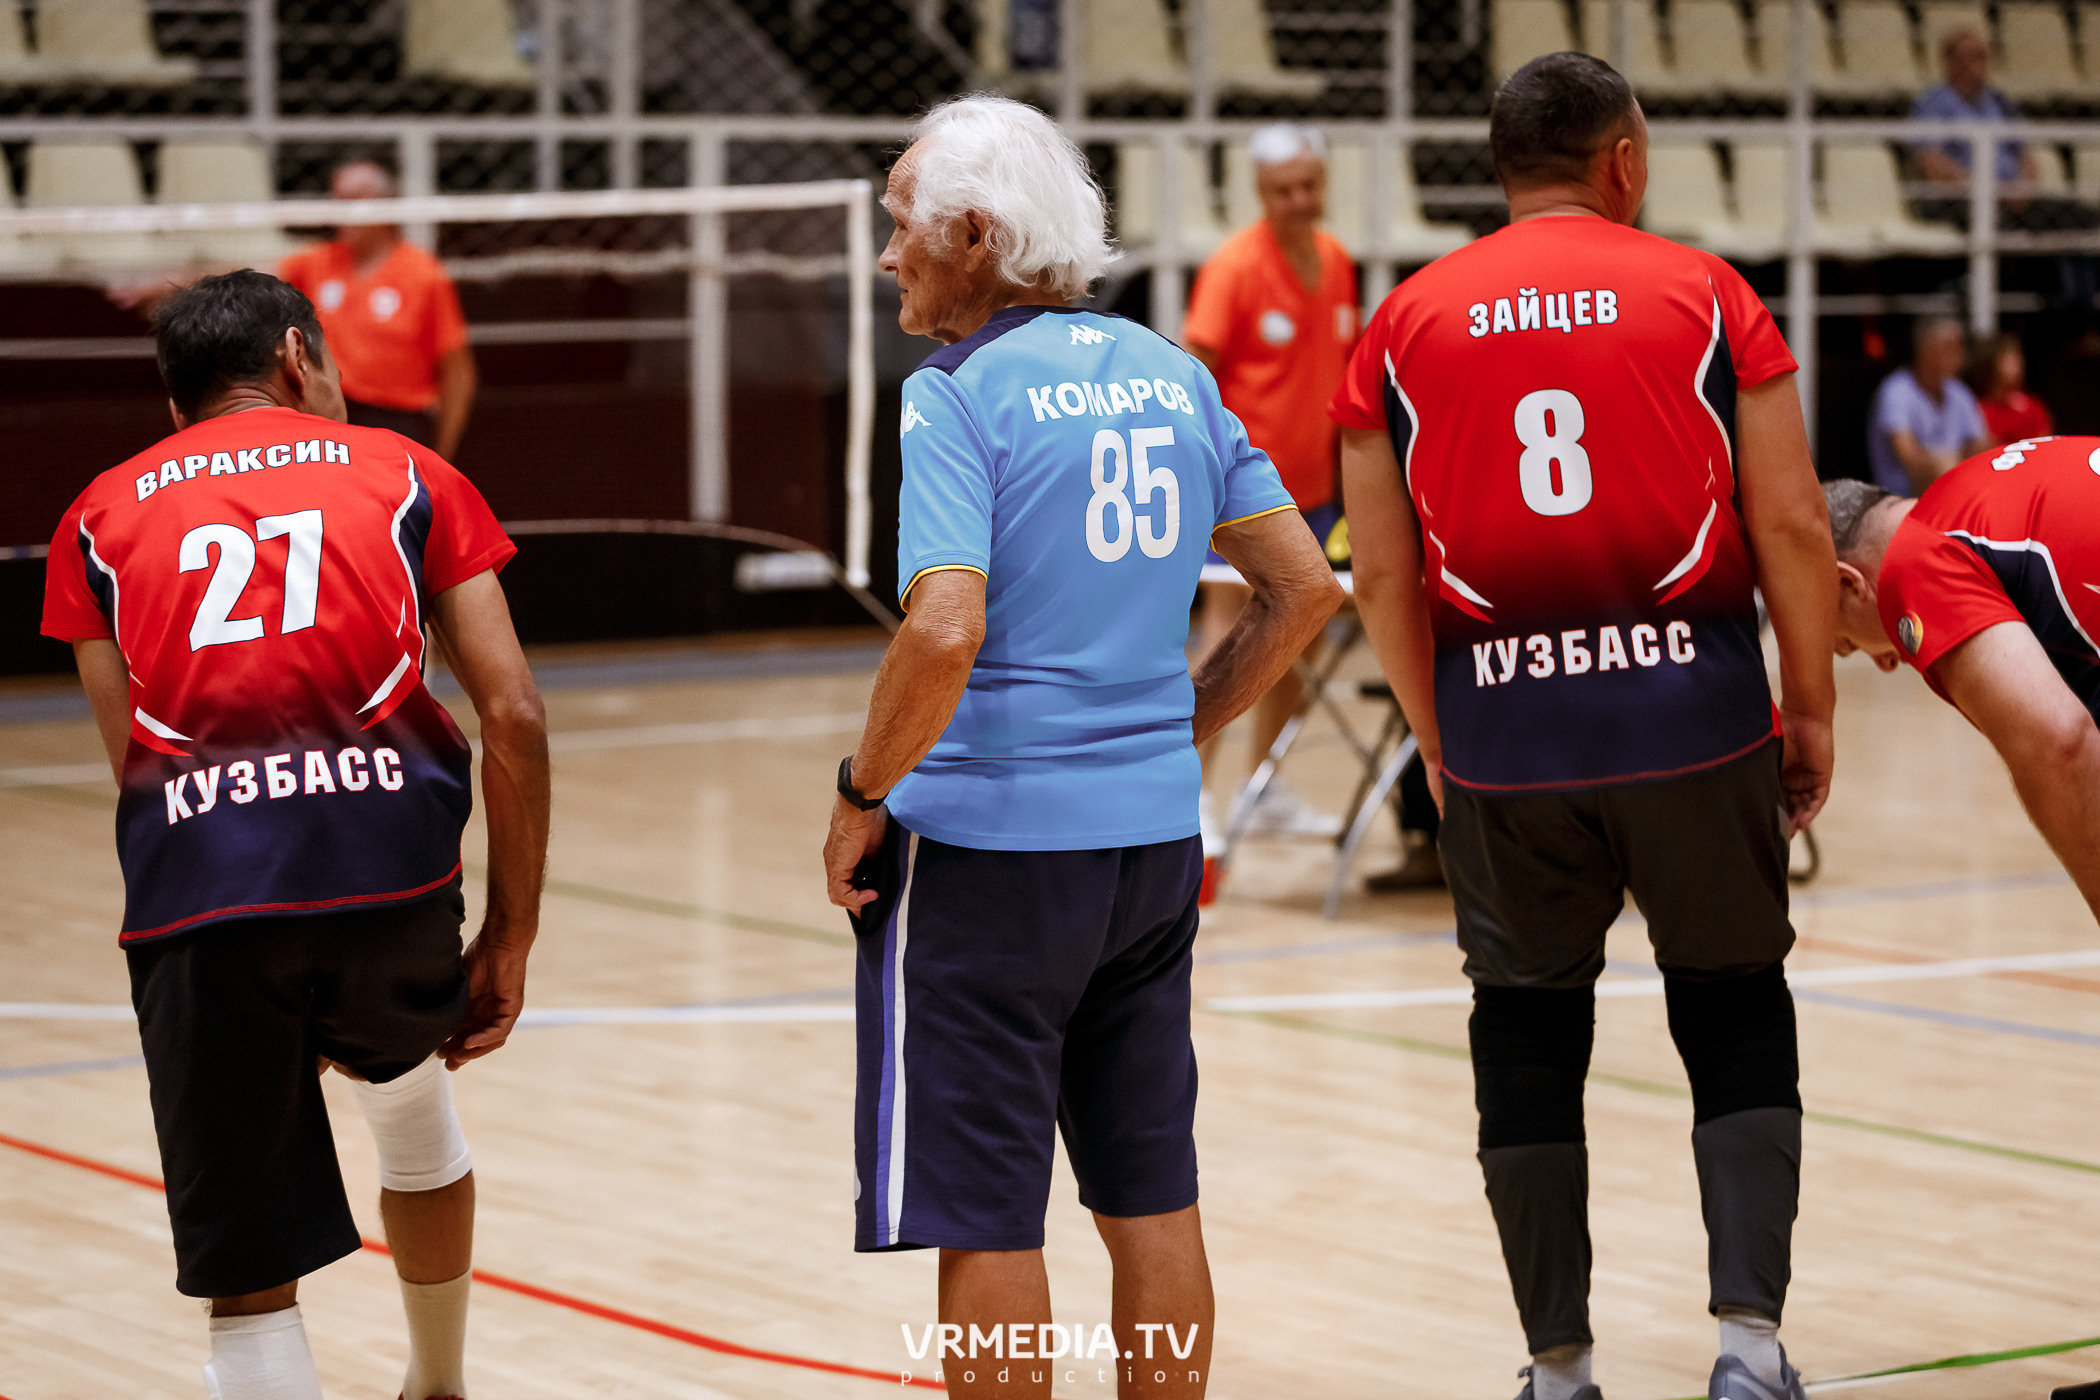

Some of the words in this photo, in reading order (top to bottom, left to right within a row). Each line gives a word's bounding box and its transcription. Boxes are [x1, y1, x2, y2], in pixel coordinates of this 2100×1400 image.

[1468, 286, 1619, 338] ЗАЙЦЕВ
[1026, 377, 1195, 423] КОМАРОВ
[135, 439, 350, 502] ВАРАКСИН
[1514, 389, 1593, 516] 8
[1086, 426, 1180, 562] 85
[178, 509, 324, 653] 27
[1472, 620, 1696, 687] КУЗБАСС
[164, 747, 404, 826] КУЗБАСС
